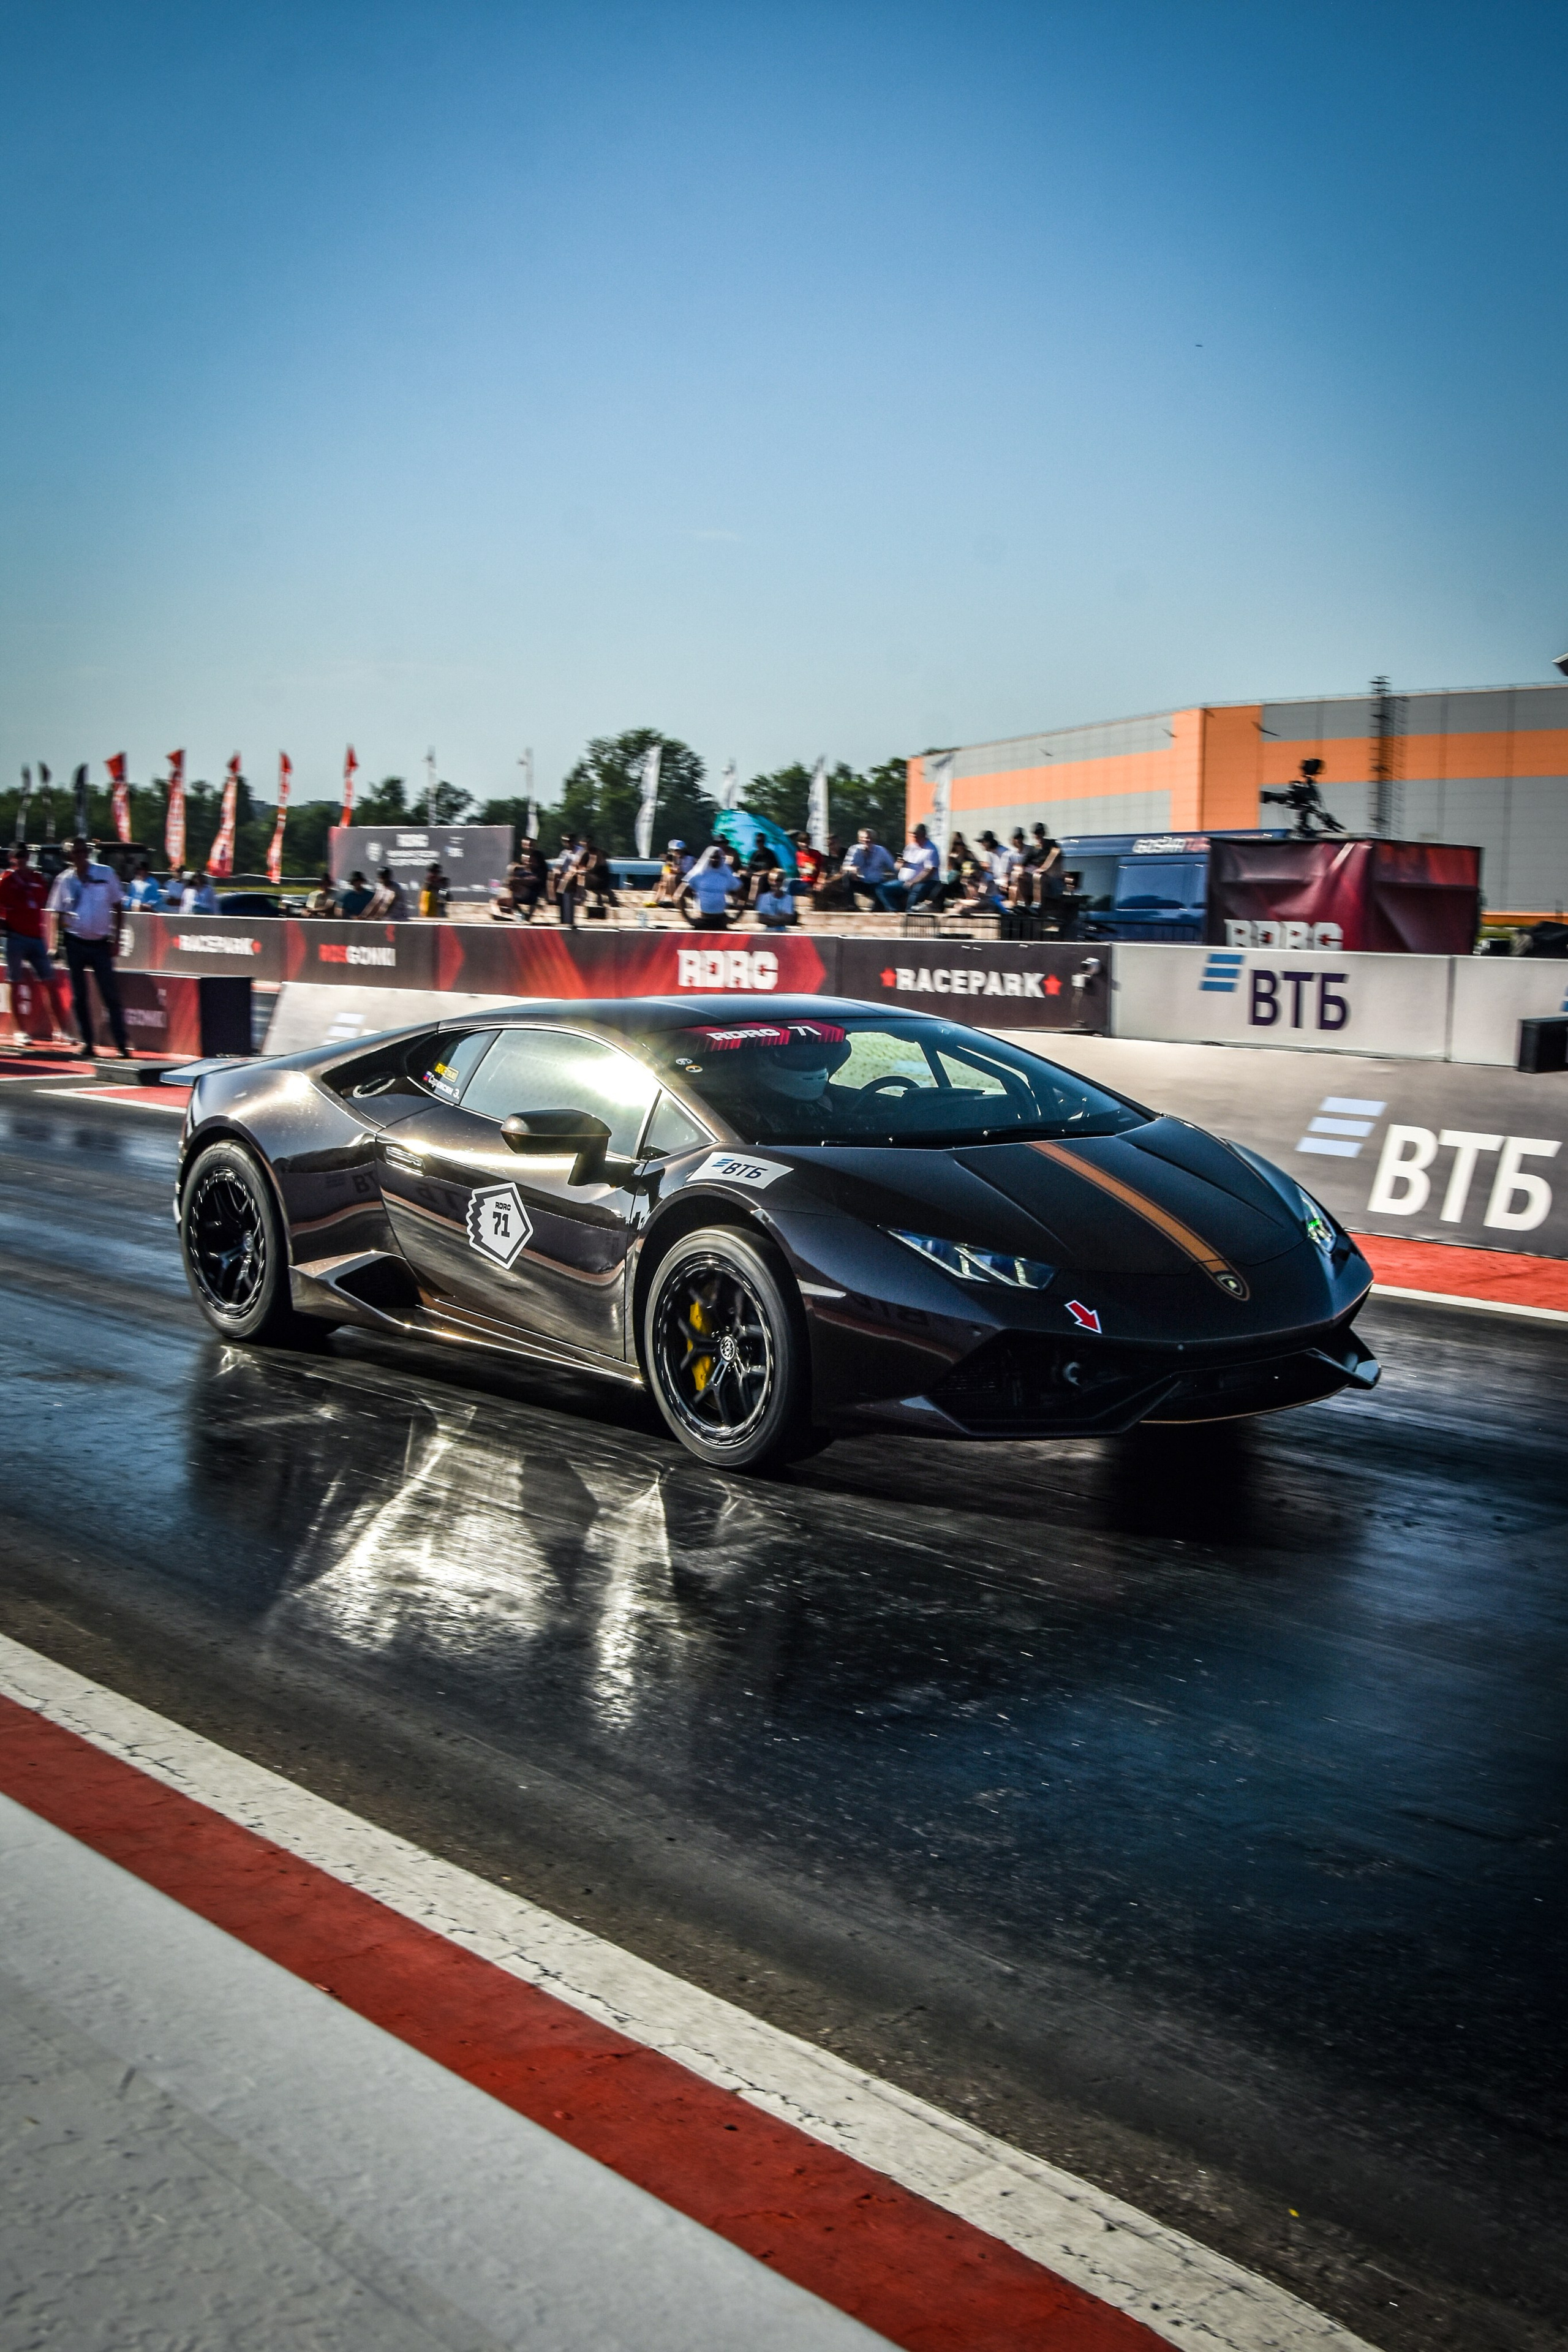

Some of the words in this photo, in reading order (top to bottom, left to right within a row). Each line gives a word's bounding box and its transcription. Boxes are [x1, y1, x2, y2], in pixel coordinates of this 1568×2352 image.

[178, 935, 255, 956] RACEPARK
[895, 968, 1046, 998] RACEPARK
[1248, 969, 1350, 1031] ВТБ
[788, 1026, 821, 1036] 71
[721, 1163, 769, 1179] ВТБ
[1366, 1124, 1563, 1232] ВТБ
[495, 1202, 511, 1211] RDRC
[492, 1211, 510, 1238] 71
